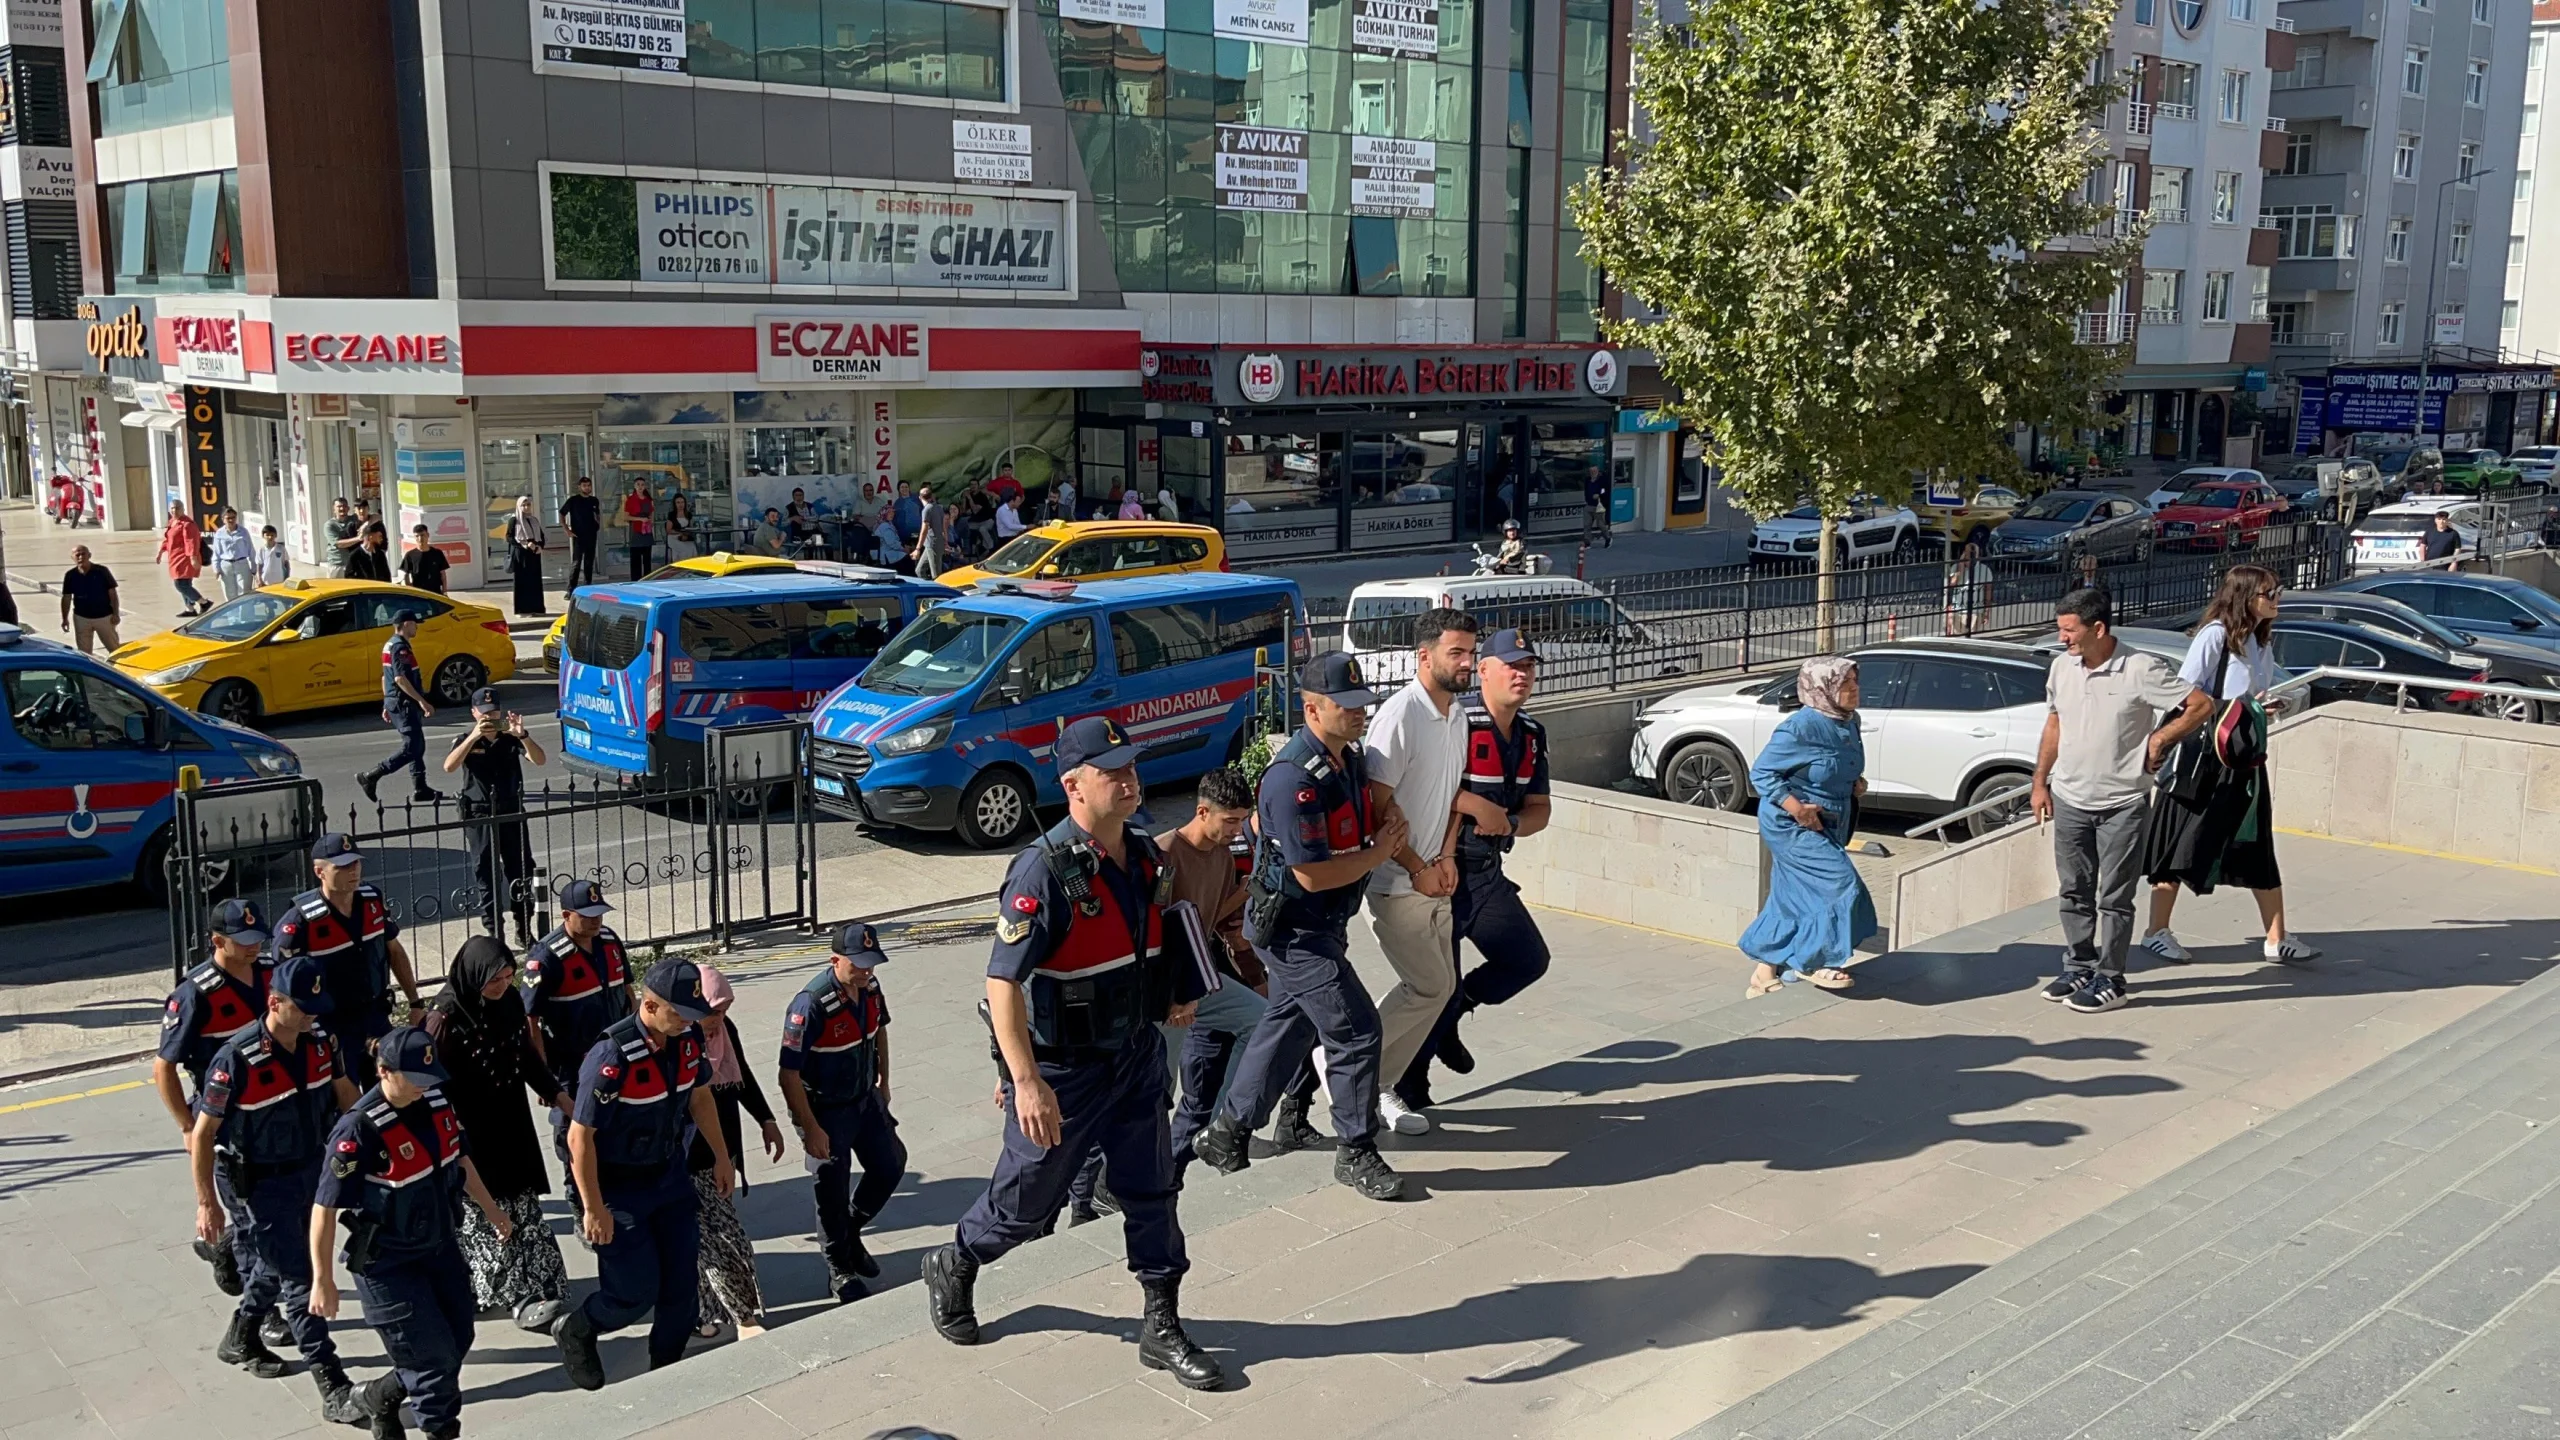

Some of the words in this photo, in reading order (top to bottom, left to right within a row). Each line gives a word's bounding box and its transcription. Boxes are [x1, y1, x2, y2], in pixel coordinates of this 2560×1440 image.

[1247, 1, 1276, 11] AVUKAT
[1365, 1, 1427, 23] AVUKAT
[543, 5, 558, 20] Av.
[561, 8, 602, 26] Ayşegül
[605, 12, 641, 30] BEKTAŞ
[643, 16, 683, 33] GÜLMEN
[1230, 15, 1259, 29] METİN
[1261, 19, 1295, 33] CANSIZ
[1356, 17, 1395, 37] GÖKHAN
[1398, 24, 1436, 42] TURHAN
[578, 28, 586, 44] 0
[589, 30, 613, 47] 535
[614, 32, 635, 49] 437
[639, 35, 654, 51] 96
[657, 37, 672, 53] 25
[549, 49, 563, 60] KAT:
[565, 49, 571, 60] 2
[639, 57, 660, 69] DAİRE:
[661, 58, 680, 71] 202
[968, 124, 1017, 142] ÖLKER
[1237, 131, 1301, 154] AVUKAT
[1370, 140, 1416, 155] ANADOLU
[974, 157, 996, 166] Fidan
[997, 157, 1026, 168] ÖLKER
[1225, 156, 1237, 169] Av.
[1239, 157, 1272, 171] Mustafa
[1353, 153, 1377, 164] HUKUK
[1379, 156, 1384, 164] &
[1385, 156, 1431, 168] DANIŞMANLIK
[960, 167, 983, 177] 0542
[985, 168, 1002, 178] 415
[1004, 169, 1015, 179] 81
[1018, 170, 1030, 180] 28
[1226, 174, 1239, 187] Av.
[1240, 175, 1274, 189] Mehmet
[1275, 177, 1298, 190] TEZER
[1368, 167, 1417, 182] AVUKAT
[28, 187, 74, 198] YALÇIN
[1364, 183, 1386, 193] HALİL
[1388, 184, 1420, 195] İBRAHİM
[655, 193, 754, 217] PHILIPS
[1227, 191, 1252, 206] KAT:2
[1253, 192, 1297, 209] DAİRE:201
[1364, 194, 1420, 206] MAHMUTOĞLU
[1353, 205, 1370, 213] 0532
[1371, 206, 1382, 214] 797
[658, 223, 750, 250] oticon
[782, 208, 919, 271] İŞİTME
[929, 223, 1054, 268] CİHAZI
[658, 256, 692, 273] 0282
[696, 257, 721, 273] 726
[725, 258, 741, 274] 76
[744, 258, 759, 274] 10
[940, 272, 962, 283] SATIŞ
[974, 273, 1015, 284] UYGULAMA
[1016, 274, 1048, 283] MERKEZİ
[86, 304, 146, 372] optik
[173, 315, 238, 355] ECZANE
[770, 322, 920, 357] ECZANE
[285, 332, 448, 363] ECZANE
[197, 356, 225, 372] DERMAN
[812, 359, 881, 373] DERMAN
[1252, 364, 1273, 385] HB
[1296, 357, 1409, 397] HARİKA
[1415, 355, 1509, 395] BÖREK
[1514, 355, 1576, 393] PİDE
[2367, 373, 2399, 392] İŞİTME
[2401, 374, 2453, 391] CİHZLARI
[1593, 384, 1609, 392] CAFE
[874, 402, 893, 507] ECZA
[1367, 519, 1402, 533] HARİKA
[1403, 516, 1435, 530] BÖREK
[2375, 551, 2400, 559] POLİS
[673, 661, 691, 673] 112
[573, 692, 616, 716] JANDARMA
[801, 690, 831, 709] JA
[1126, 687, 1221, 723] JANDARMA
[829, 700, 890, 718] JANDARMA
